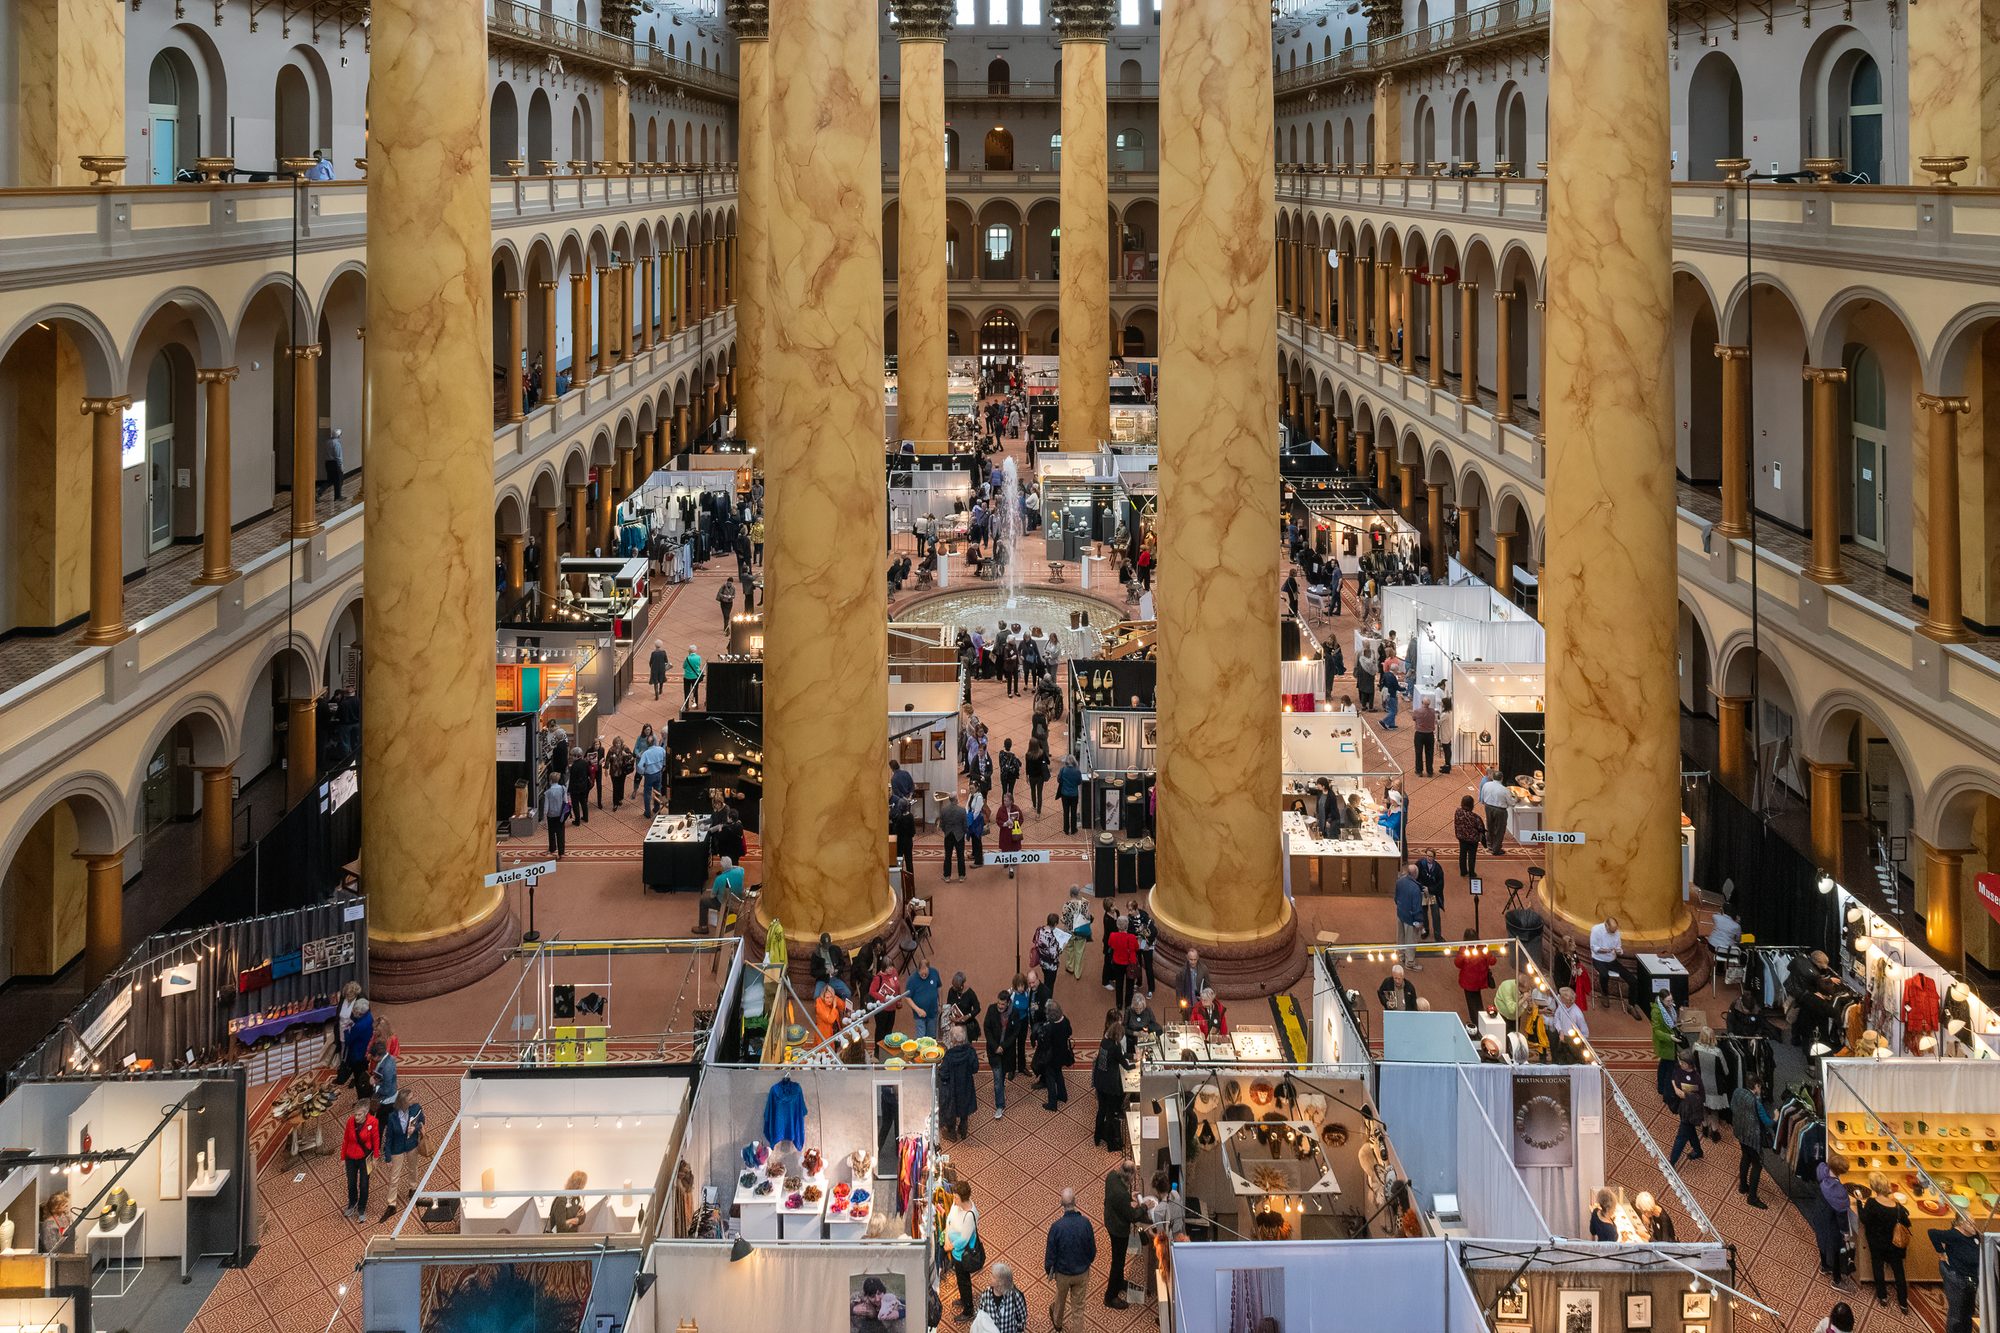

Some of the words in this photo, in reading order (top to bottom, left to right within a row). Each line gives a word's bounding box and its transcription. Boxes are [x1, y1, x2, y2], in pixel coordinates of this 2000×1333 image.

[1530, 833, 1554, 842] Aisle
[1557, 834, 1576, 842] 100
[994, 854, 1018, 863] Aisle
[1020, 853, 1040, 863] 200
[496, 871, 522, 884] Aisle
[525, 865, 546, 877] 300
